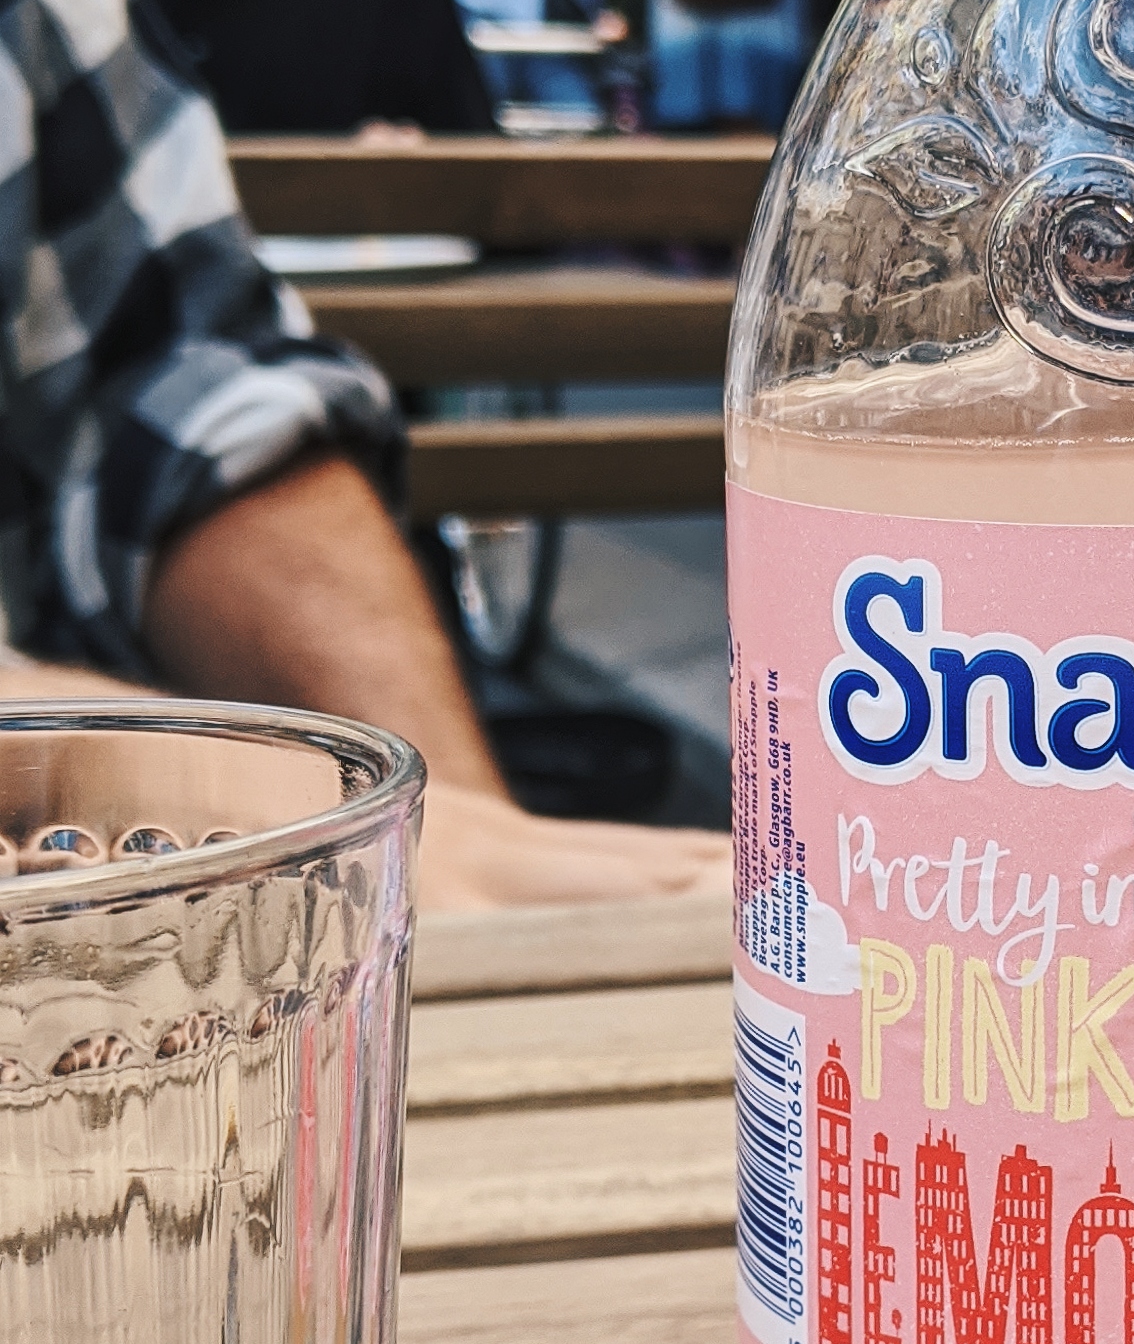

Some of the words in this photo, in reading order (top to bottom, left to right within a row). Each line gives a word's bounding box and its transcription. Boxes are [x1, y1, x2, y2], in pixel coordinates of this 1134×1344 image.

[767, 668, 779, 693] UK
[749, 680, 758, 747] Snapple
[767, 696, 780, 735] 9HD,
[749, 747, 758, 769] of
[768, 738, 780, 770] G68
[750, 770, 758, 815] mark
[768, 774, 782, 849] Glasgow,
[750, 817, 758, 863] trade
[759, 845, 768, 887] Corp.
[780, 741, 795, 979] consumercare@agbarr.co.uk
[759, 889, 768, 967] Beverage
[769, 900, 781, 938] Barr
[794, 841, 808, 983] www.snapple.eu
[838, 813, 1075, 987] Pretty
[751, 895, 759, 962] Snapple
[770, 940, 781, 974] A.G.
[787, 1057, 803, 1175] 100645
[788, 1198, 804, 1319] 000382
